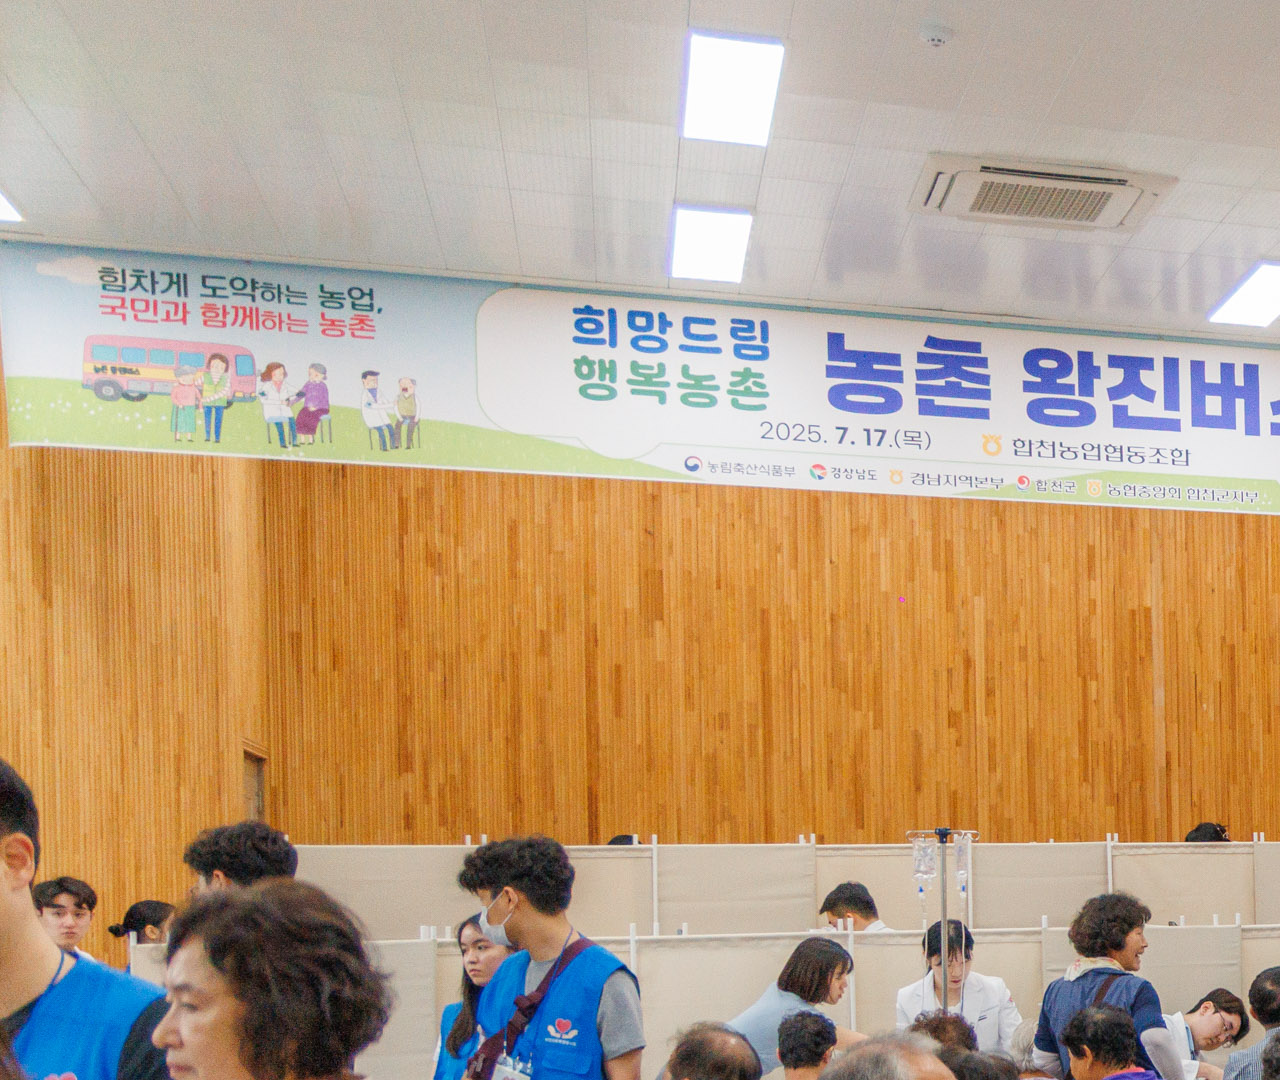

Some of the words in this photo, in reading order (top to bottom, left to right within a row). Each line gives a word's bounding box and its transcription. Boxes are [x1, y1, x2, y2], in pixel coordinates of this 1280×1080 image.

[98, 266, 189, 298] 힘차게
[200, 274, 308, 306] 도약하는
[318, 283, 383, 314] 농업,
[99, 294, 190, 325] 국민과
[200, 303, 309, 334] 함께하는
[319, 311, 377, 340] 농촌
[572, 304, 770, 361] 희망드림
[572, 355, 770, 411] 행복농촌
[825, 331, 992, 420] 농촌
[760, 421, 828, 444] 2025.
[834, 426, 856, 446] 7.
[863, 427, 932, 452] 17.(목)
[1012, 438, 1192, 466] 합천농업협동조합
[707, 461, 796, 478] 농림축산식품부
[831, 466, 878, 481] 경상남도
[911, 472, 1004, 490] 경남지역본부
[1035, 479, 1077, 493] 합천군
